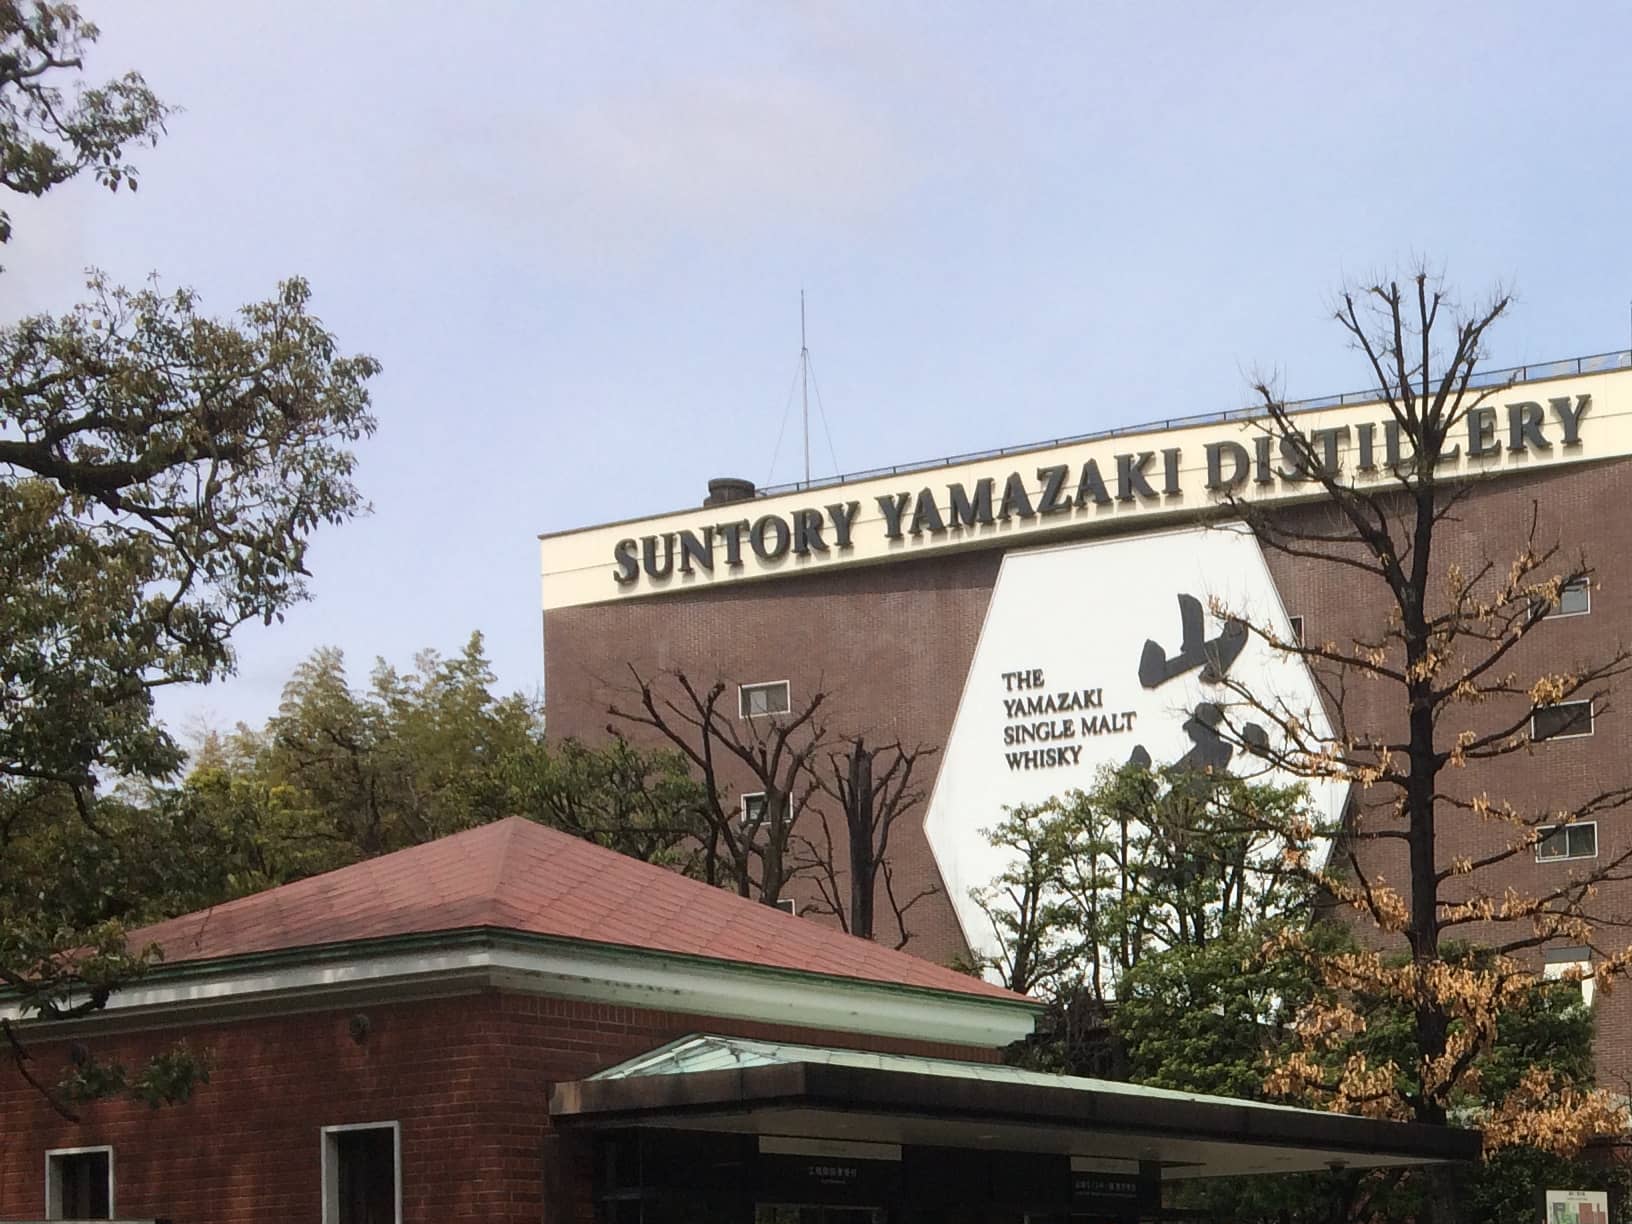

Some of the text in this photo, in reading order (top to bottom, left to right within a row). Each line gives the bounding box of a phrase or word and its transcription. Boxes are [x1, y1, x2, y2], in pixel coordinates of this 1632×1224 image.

[612, 501, 859, 586] SUNTORY
[875, 447, 1182, 539] YAMAZAKI
[1001, 668, 1045, 692] THE
[1003, 687, 1104, 719] YAMAZAKI
[1003, 711, 1137, 746] SINGLE MALT
[1005, 745, 1083, 771] WHISKY
